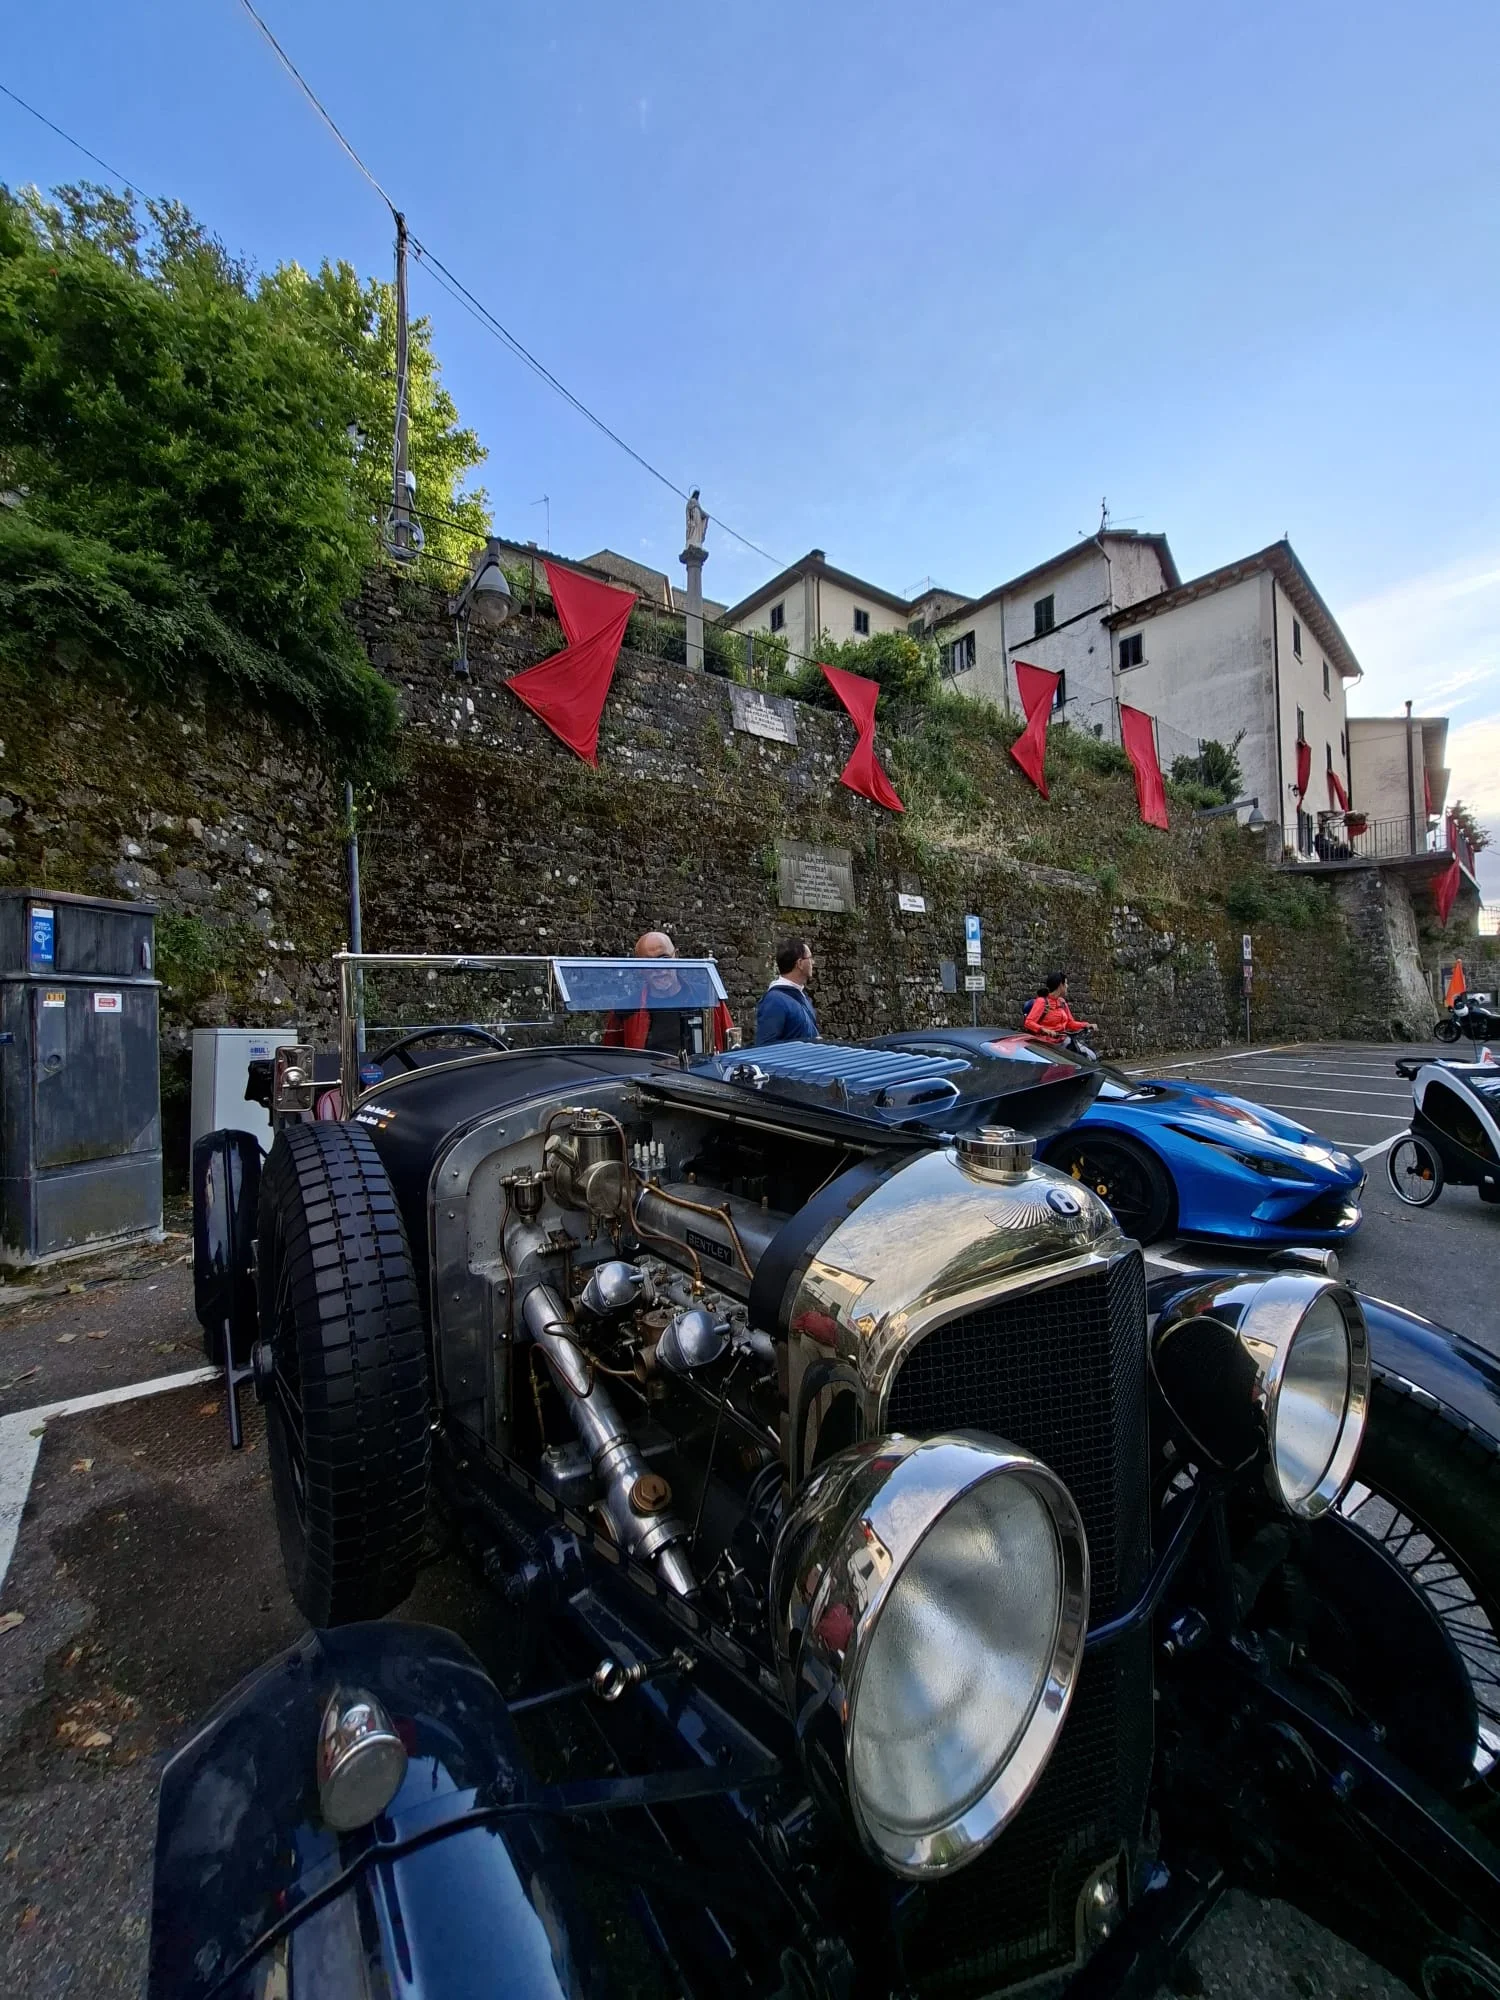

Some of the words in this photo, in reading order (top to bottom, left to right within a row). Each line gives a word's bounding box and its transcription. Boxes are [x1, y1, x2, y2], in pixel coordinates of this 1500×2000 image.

[968, 919, 977, 938] P
[1050, 1190, 1079, 1213] B
[688, 1233, 730, 1257] BENTLEY
